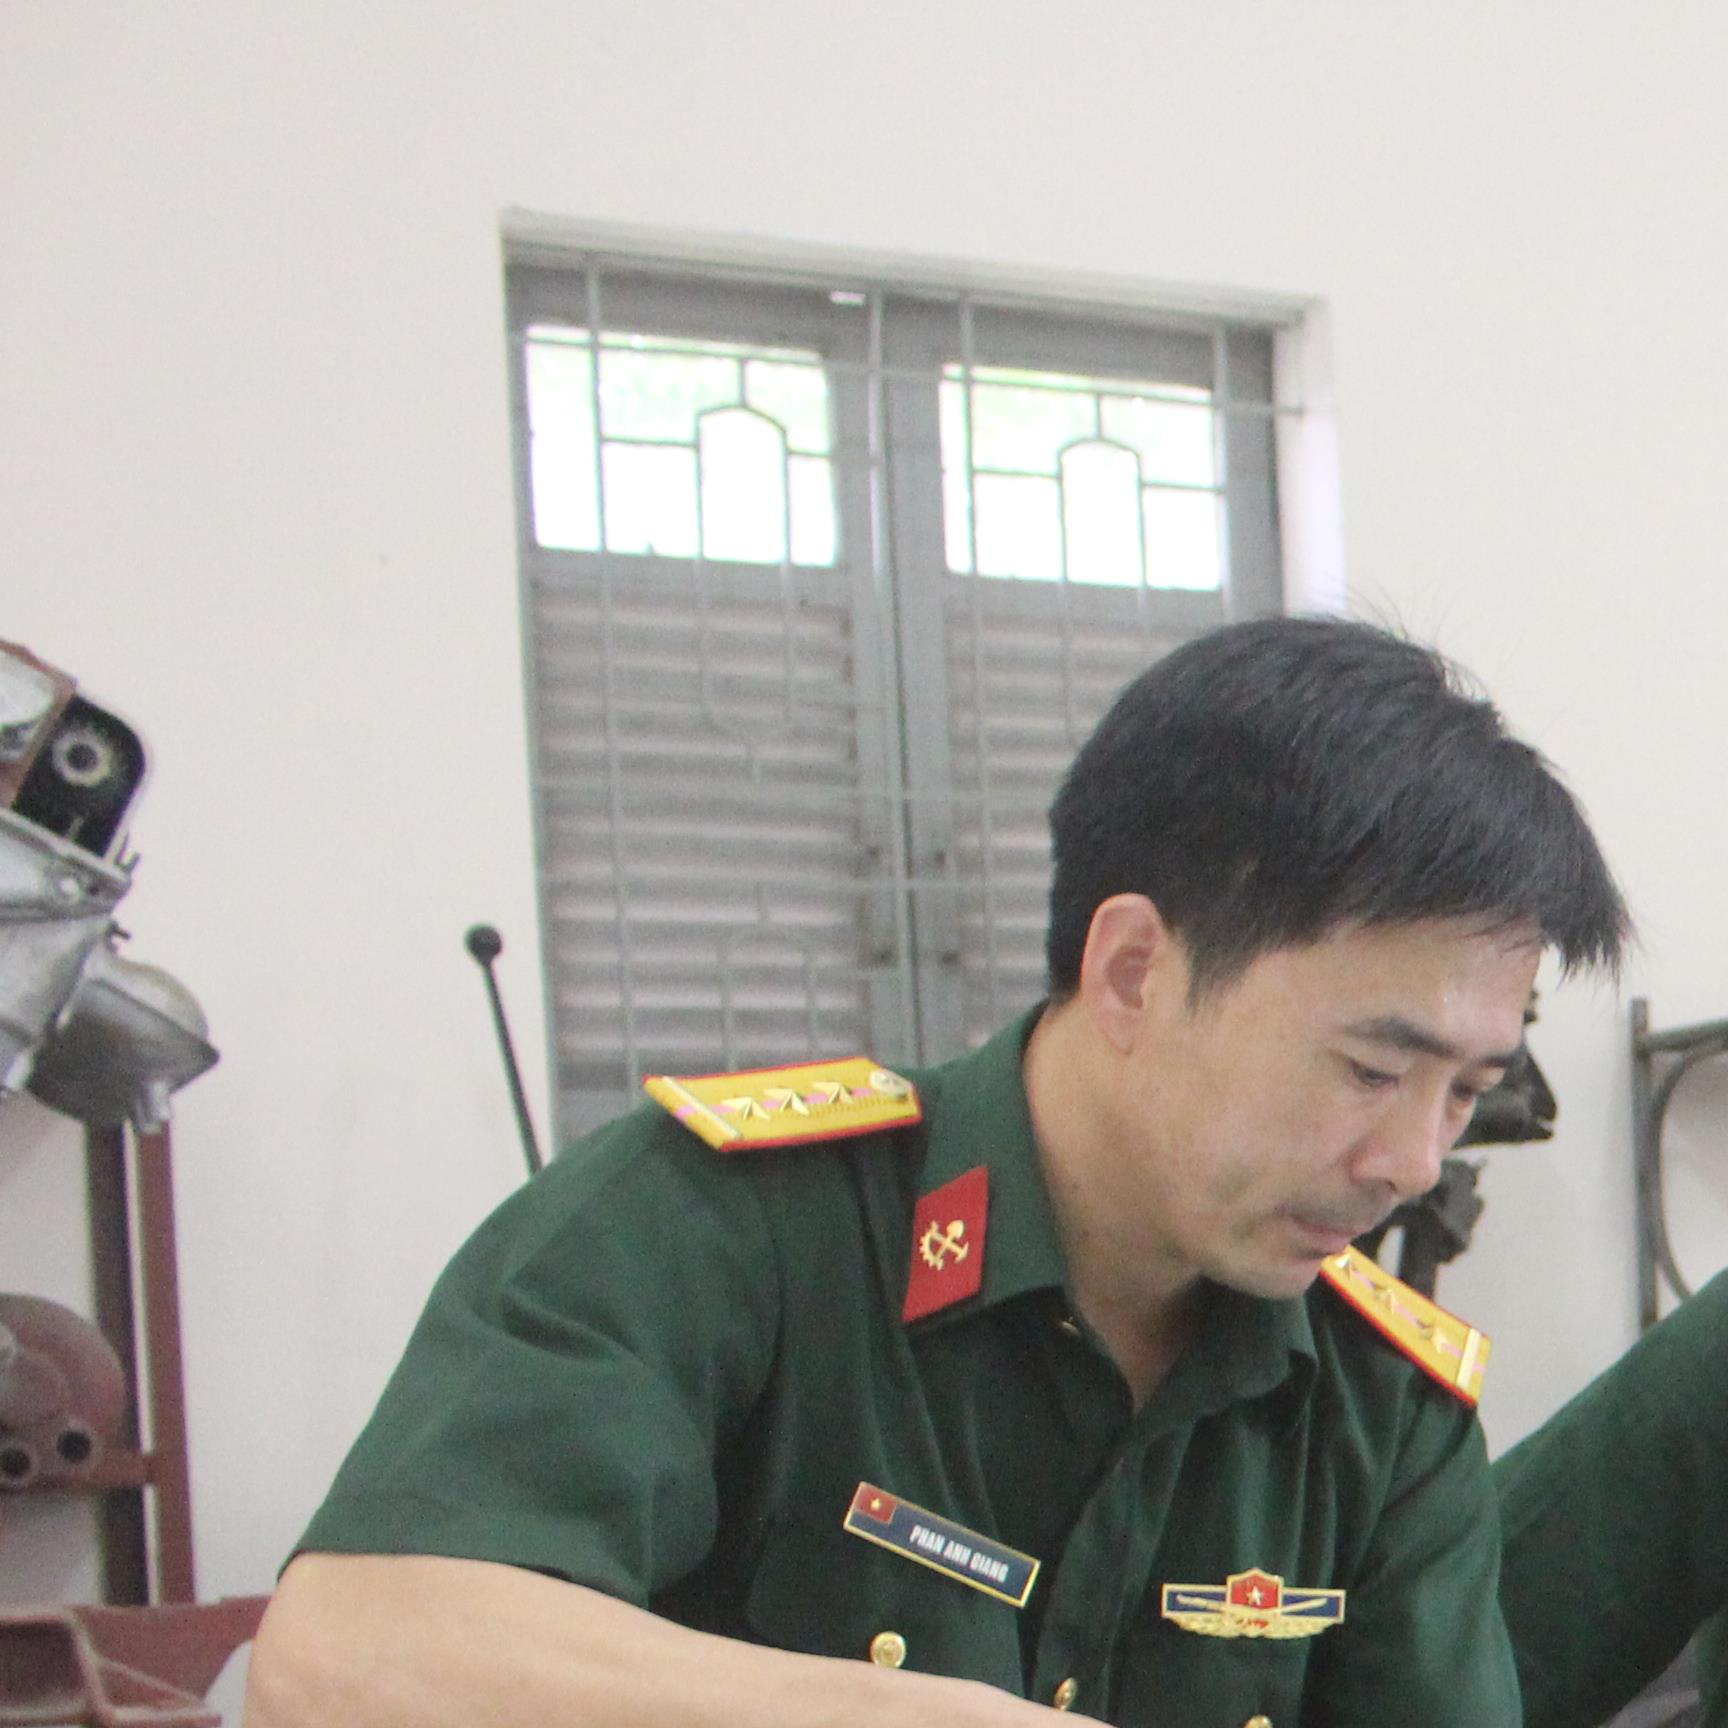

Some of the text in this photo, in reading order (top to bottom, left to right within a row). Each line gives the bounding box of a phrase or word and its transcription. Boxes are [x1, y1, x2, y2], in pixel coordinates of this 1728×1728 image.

[910, 1525, 1008, 1583] PHAN ANH GIANG
